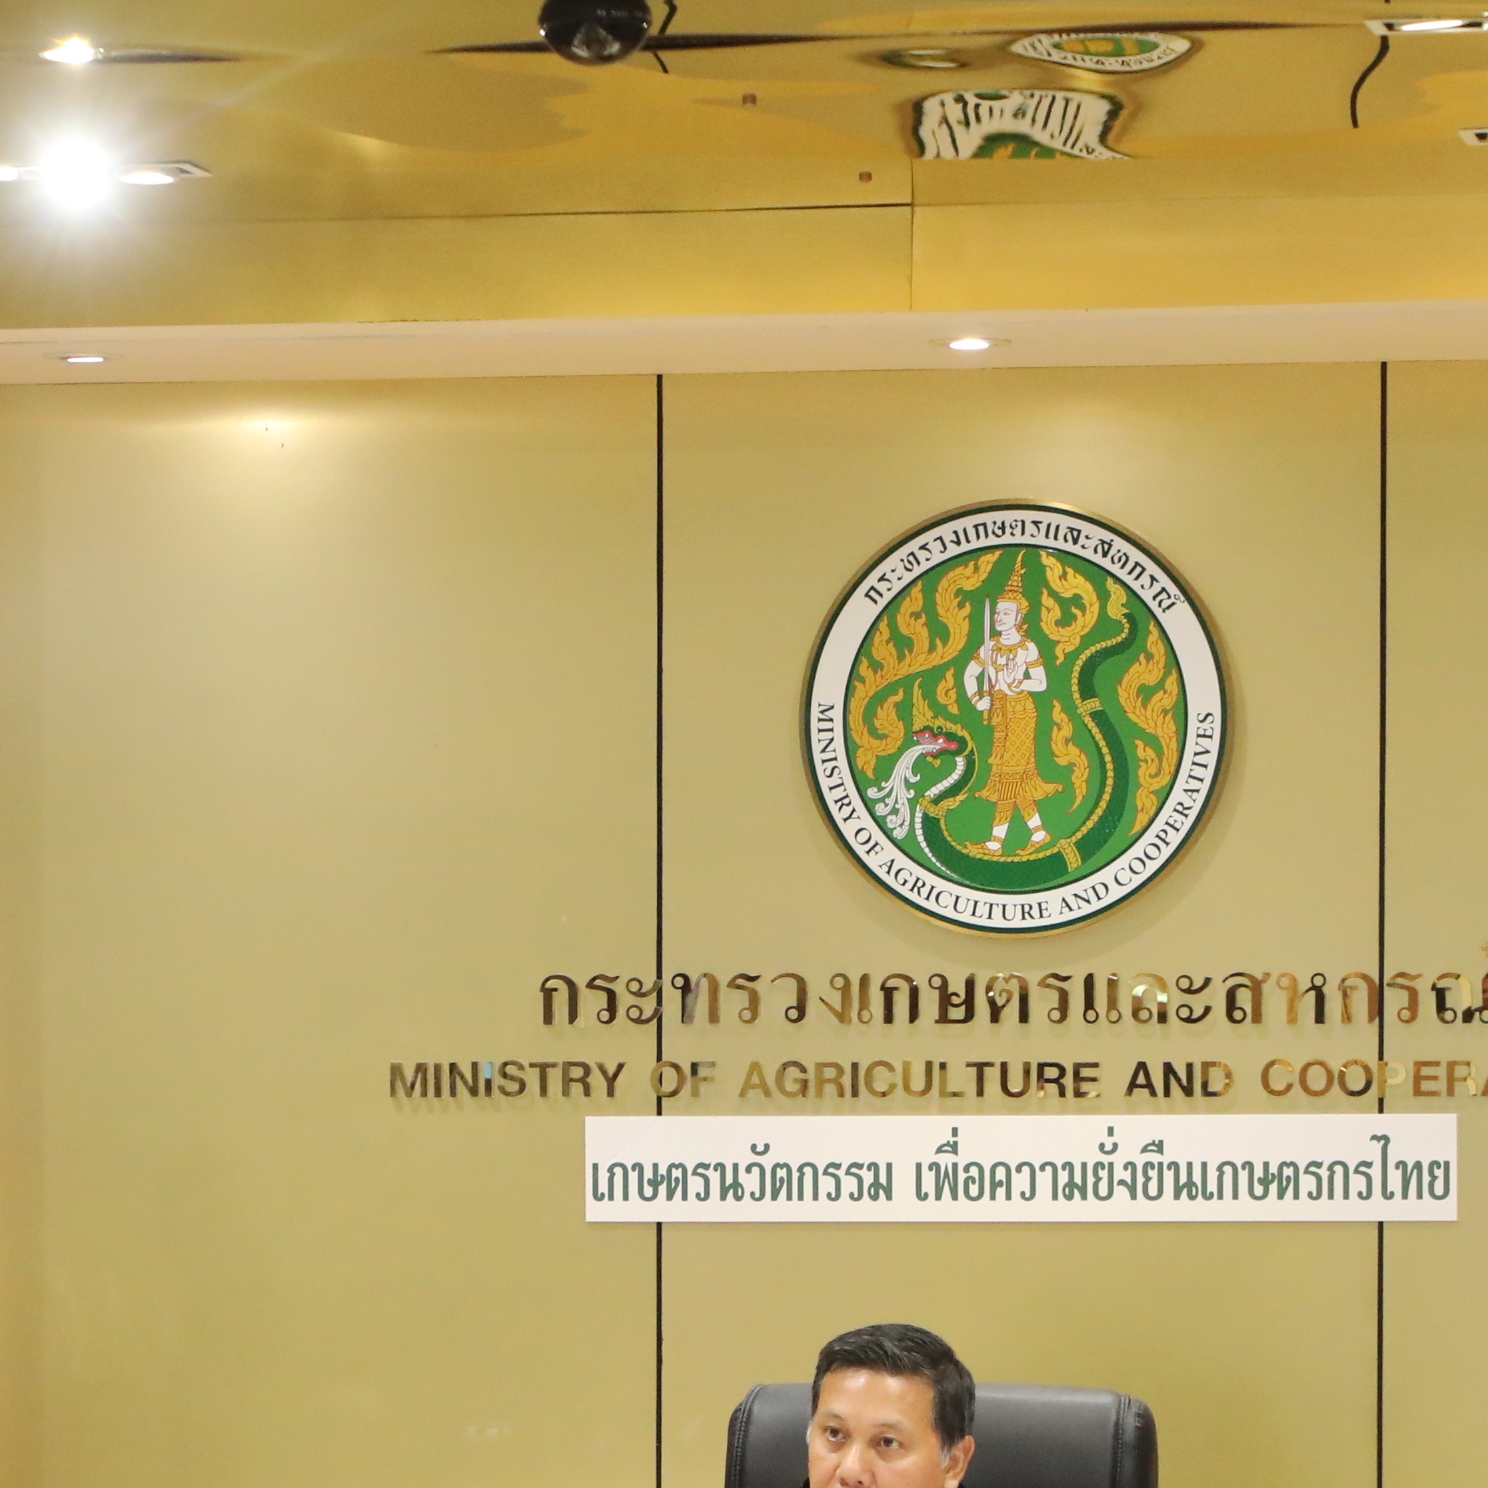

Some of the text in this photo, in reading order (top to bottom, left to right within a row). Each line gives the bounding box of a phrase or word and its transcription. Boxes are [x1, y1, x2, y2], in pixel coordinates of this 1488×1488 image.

[863, 518, 1185, 614] กระทรวงเกษตรและสหกรณ์
[817, 702, 1216, 922] MINISTRY OF AGRICULTURE AND COOPERATIVES
[389, 1060, 627, 1098] MINISTRY
[650, 1060, 717, 1098] OF
[738, 1060, 1102, 1098] AGRICULTURE
[1124, 1060, 1234, 1098] AND
[591, 1125, 1451, 1202] เกษตรนวัตกรรม เพื่อความยั่งยืนเกษตรกรไทย
